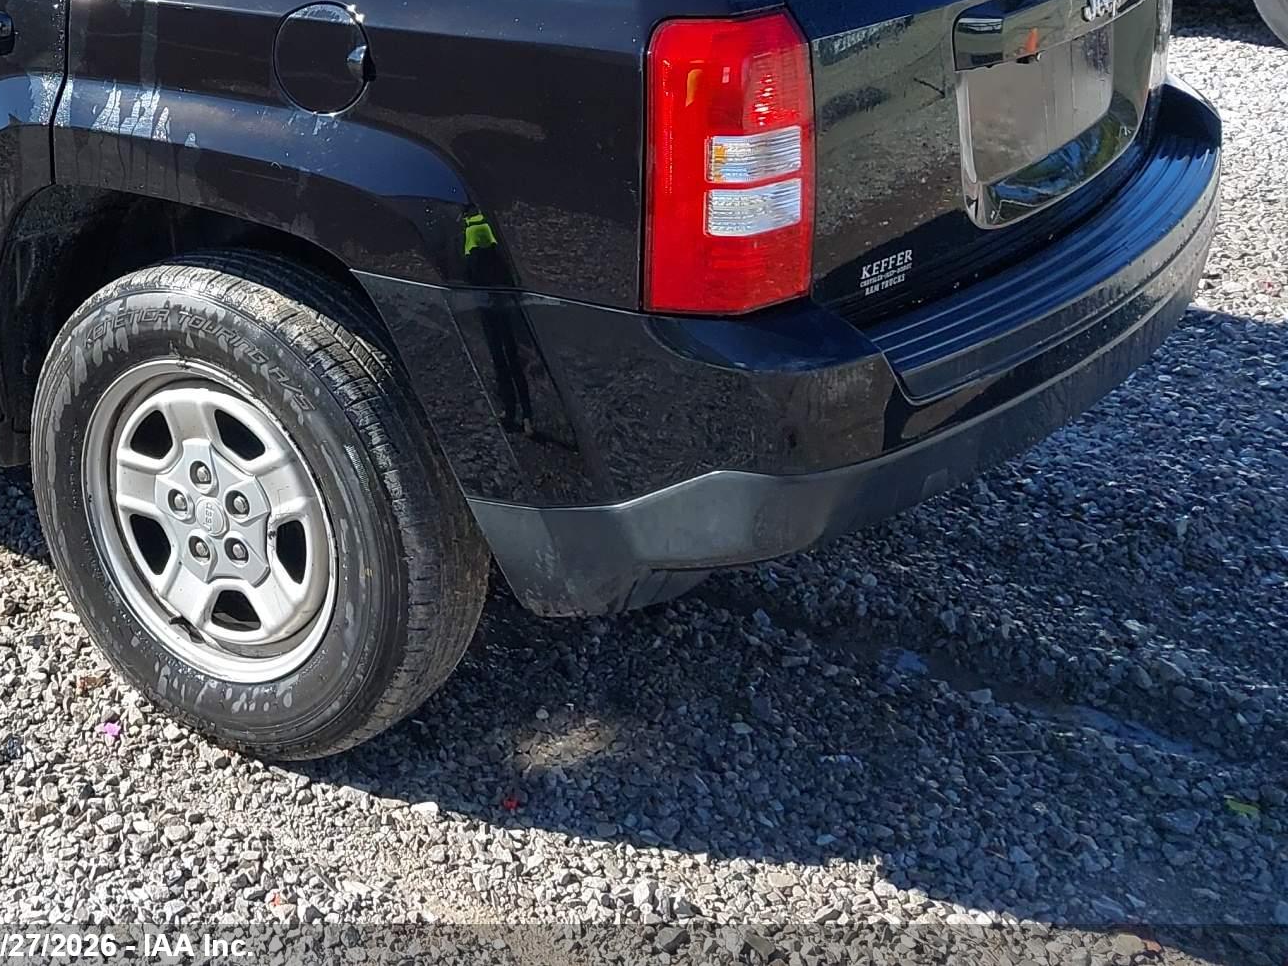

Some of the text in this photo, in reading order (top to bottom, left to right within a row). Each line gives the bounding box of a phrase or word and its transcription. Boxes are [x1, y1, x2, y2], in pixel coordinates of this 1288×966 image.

[860, 249, 913, 280] KEFFER
[864, 273, 906, 296] RAM TRUCKS
[179, 310, 270, 364] TOURING
